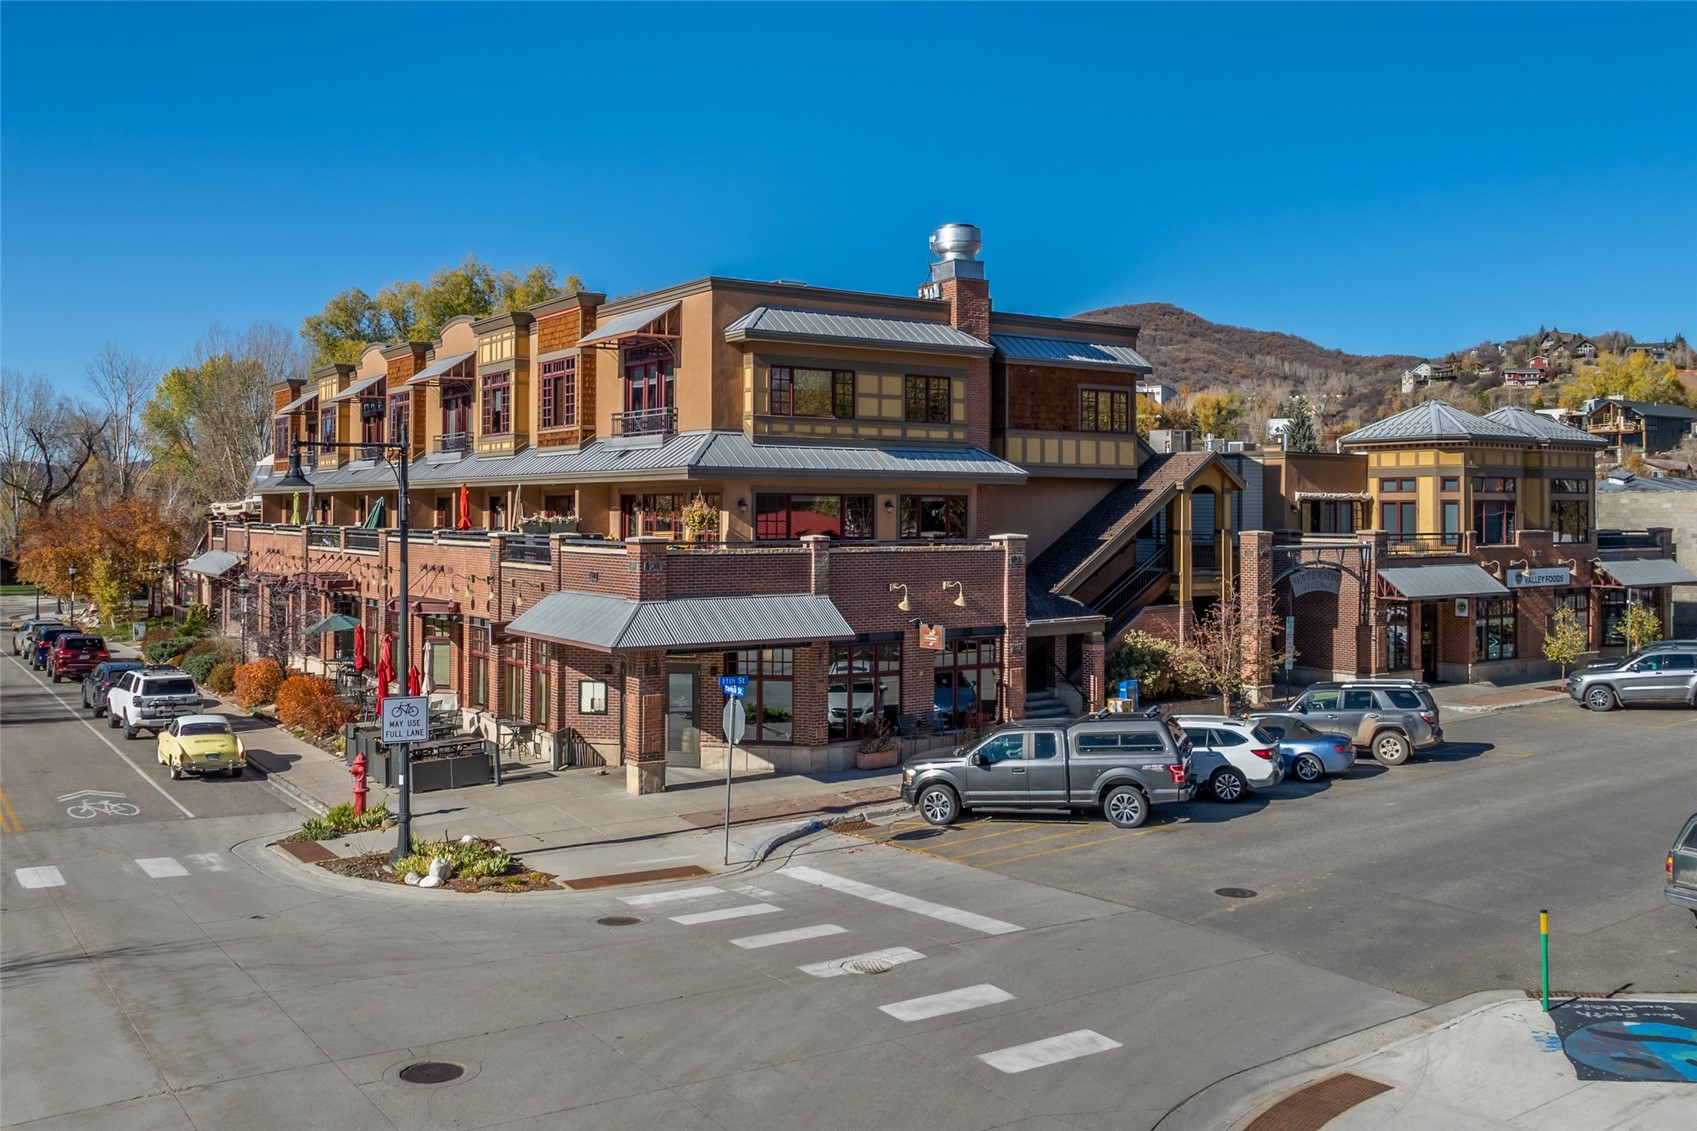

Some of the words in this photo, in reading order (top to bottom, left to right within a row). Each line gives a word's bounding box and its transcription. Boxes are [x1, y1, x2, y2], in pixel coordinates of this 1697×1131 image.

[1293, 571, 1339, 585] WATERSIDE
[1524, 575, 1545, 584] VALLEY
[1545, 574, 1564, 583] FOODS
[1302, 581, 1332, 591] VILLAGE
[722, 677, 736, 685] 11th
[389, 720, 404, 728] MAY
[407, 719, 421, 727] USE
[385, 730, 403, 738] FULL
[406, 729, 424, 737] LANE
